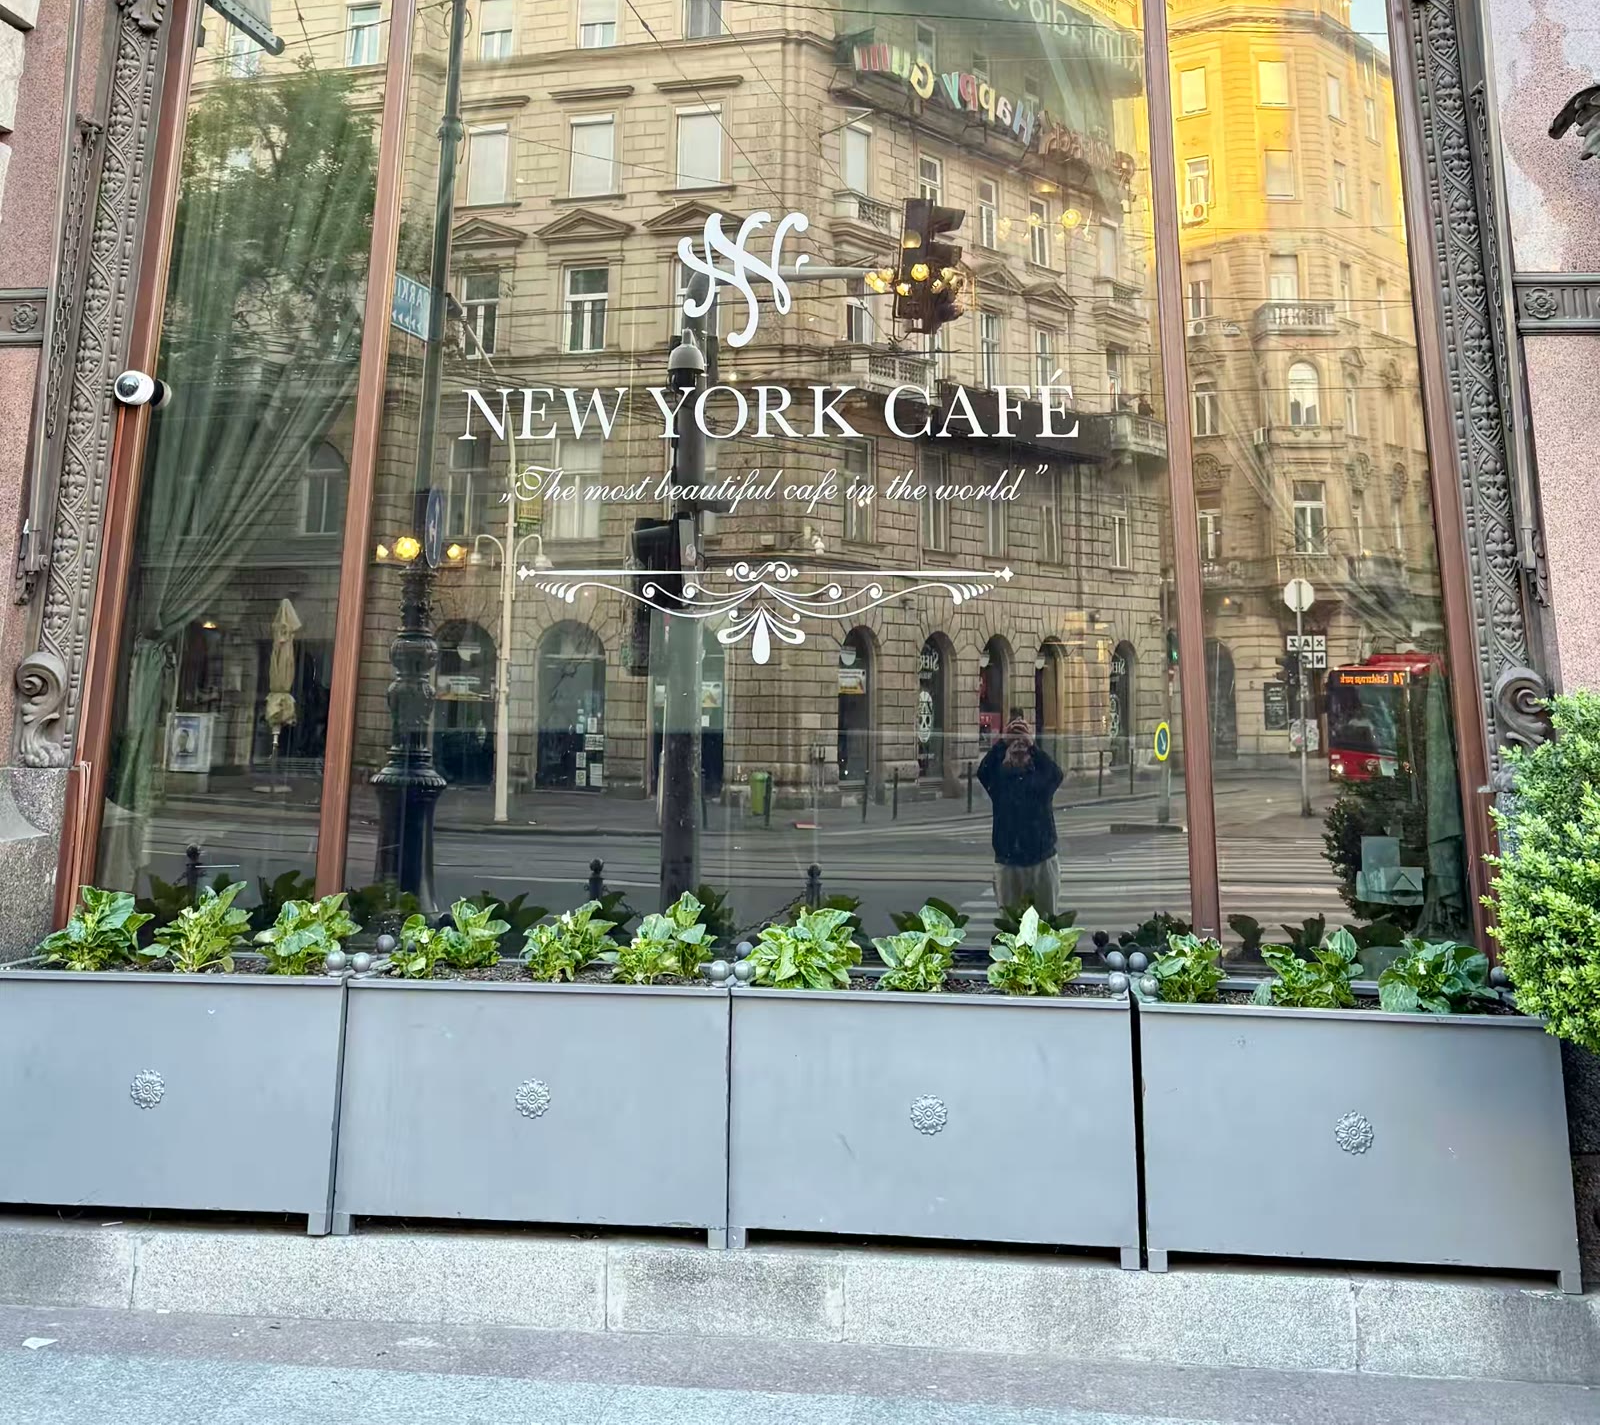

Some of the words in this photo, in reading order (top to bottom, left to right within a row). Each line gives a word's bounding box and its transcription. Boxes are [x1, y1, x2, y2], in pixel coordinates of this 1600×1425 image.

[457, 386, 629, 441] NEW
[645, 384, 864, 440] YORK
[884, 368, 1080, 439] CAFÉ
[583, 475, 653, 502] most
[653, 467, 783, 514] beautiful
[783, 467, 839, 514] cafe
[845, 475, 878, 502] in
[885, 469, 927, 501] the
